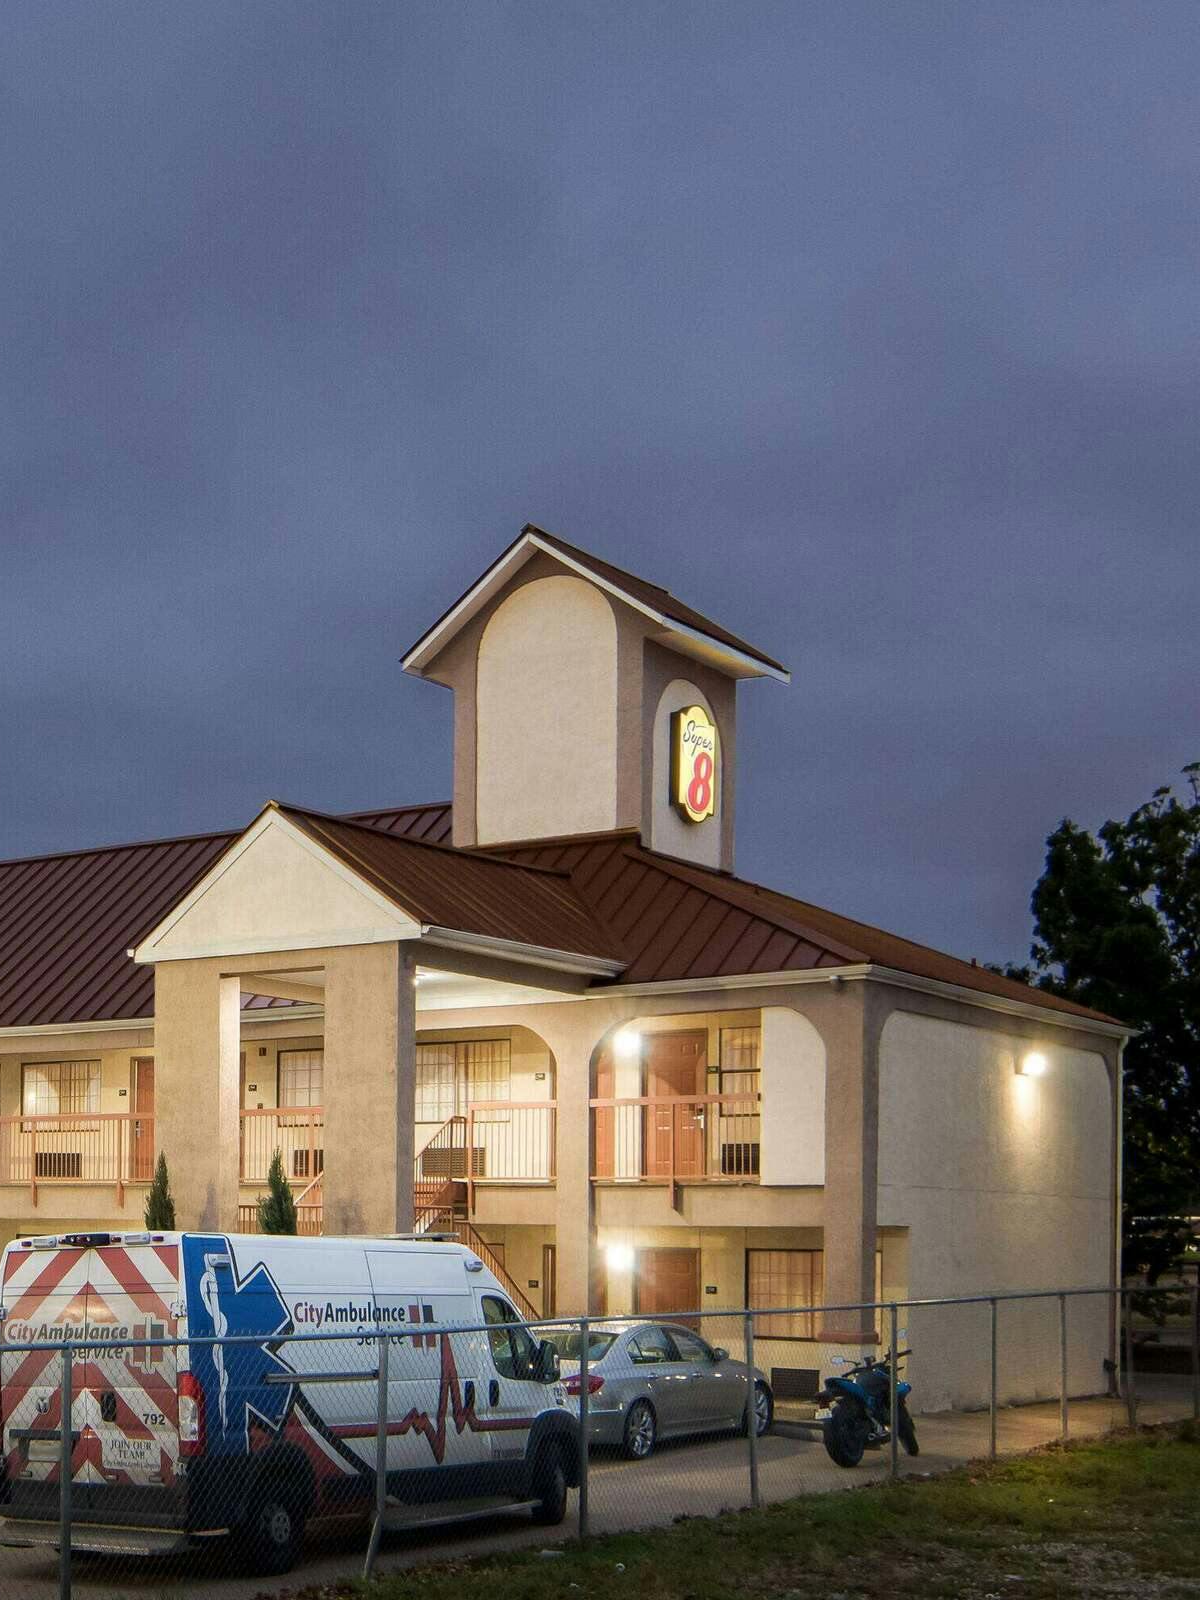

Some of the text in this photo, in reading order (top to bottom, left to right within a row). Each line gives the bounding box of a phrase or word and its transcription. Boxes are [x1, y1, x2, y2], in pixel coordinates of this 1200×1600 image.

[683, 719, 713, 757] Super
[687, 752, 712, 813] 8
[294, 1301, 406, 1328] CityAmbulance
[7, 1322, 129, 1343] CityAmbulance
[142, 1413, 166, 1425] 792
[110, 1439, 152, 1450] JOIN OUR
